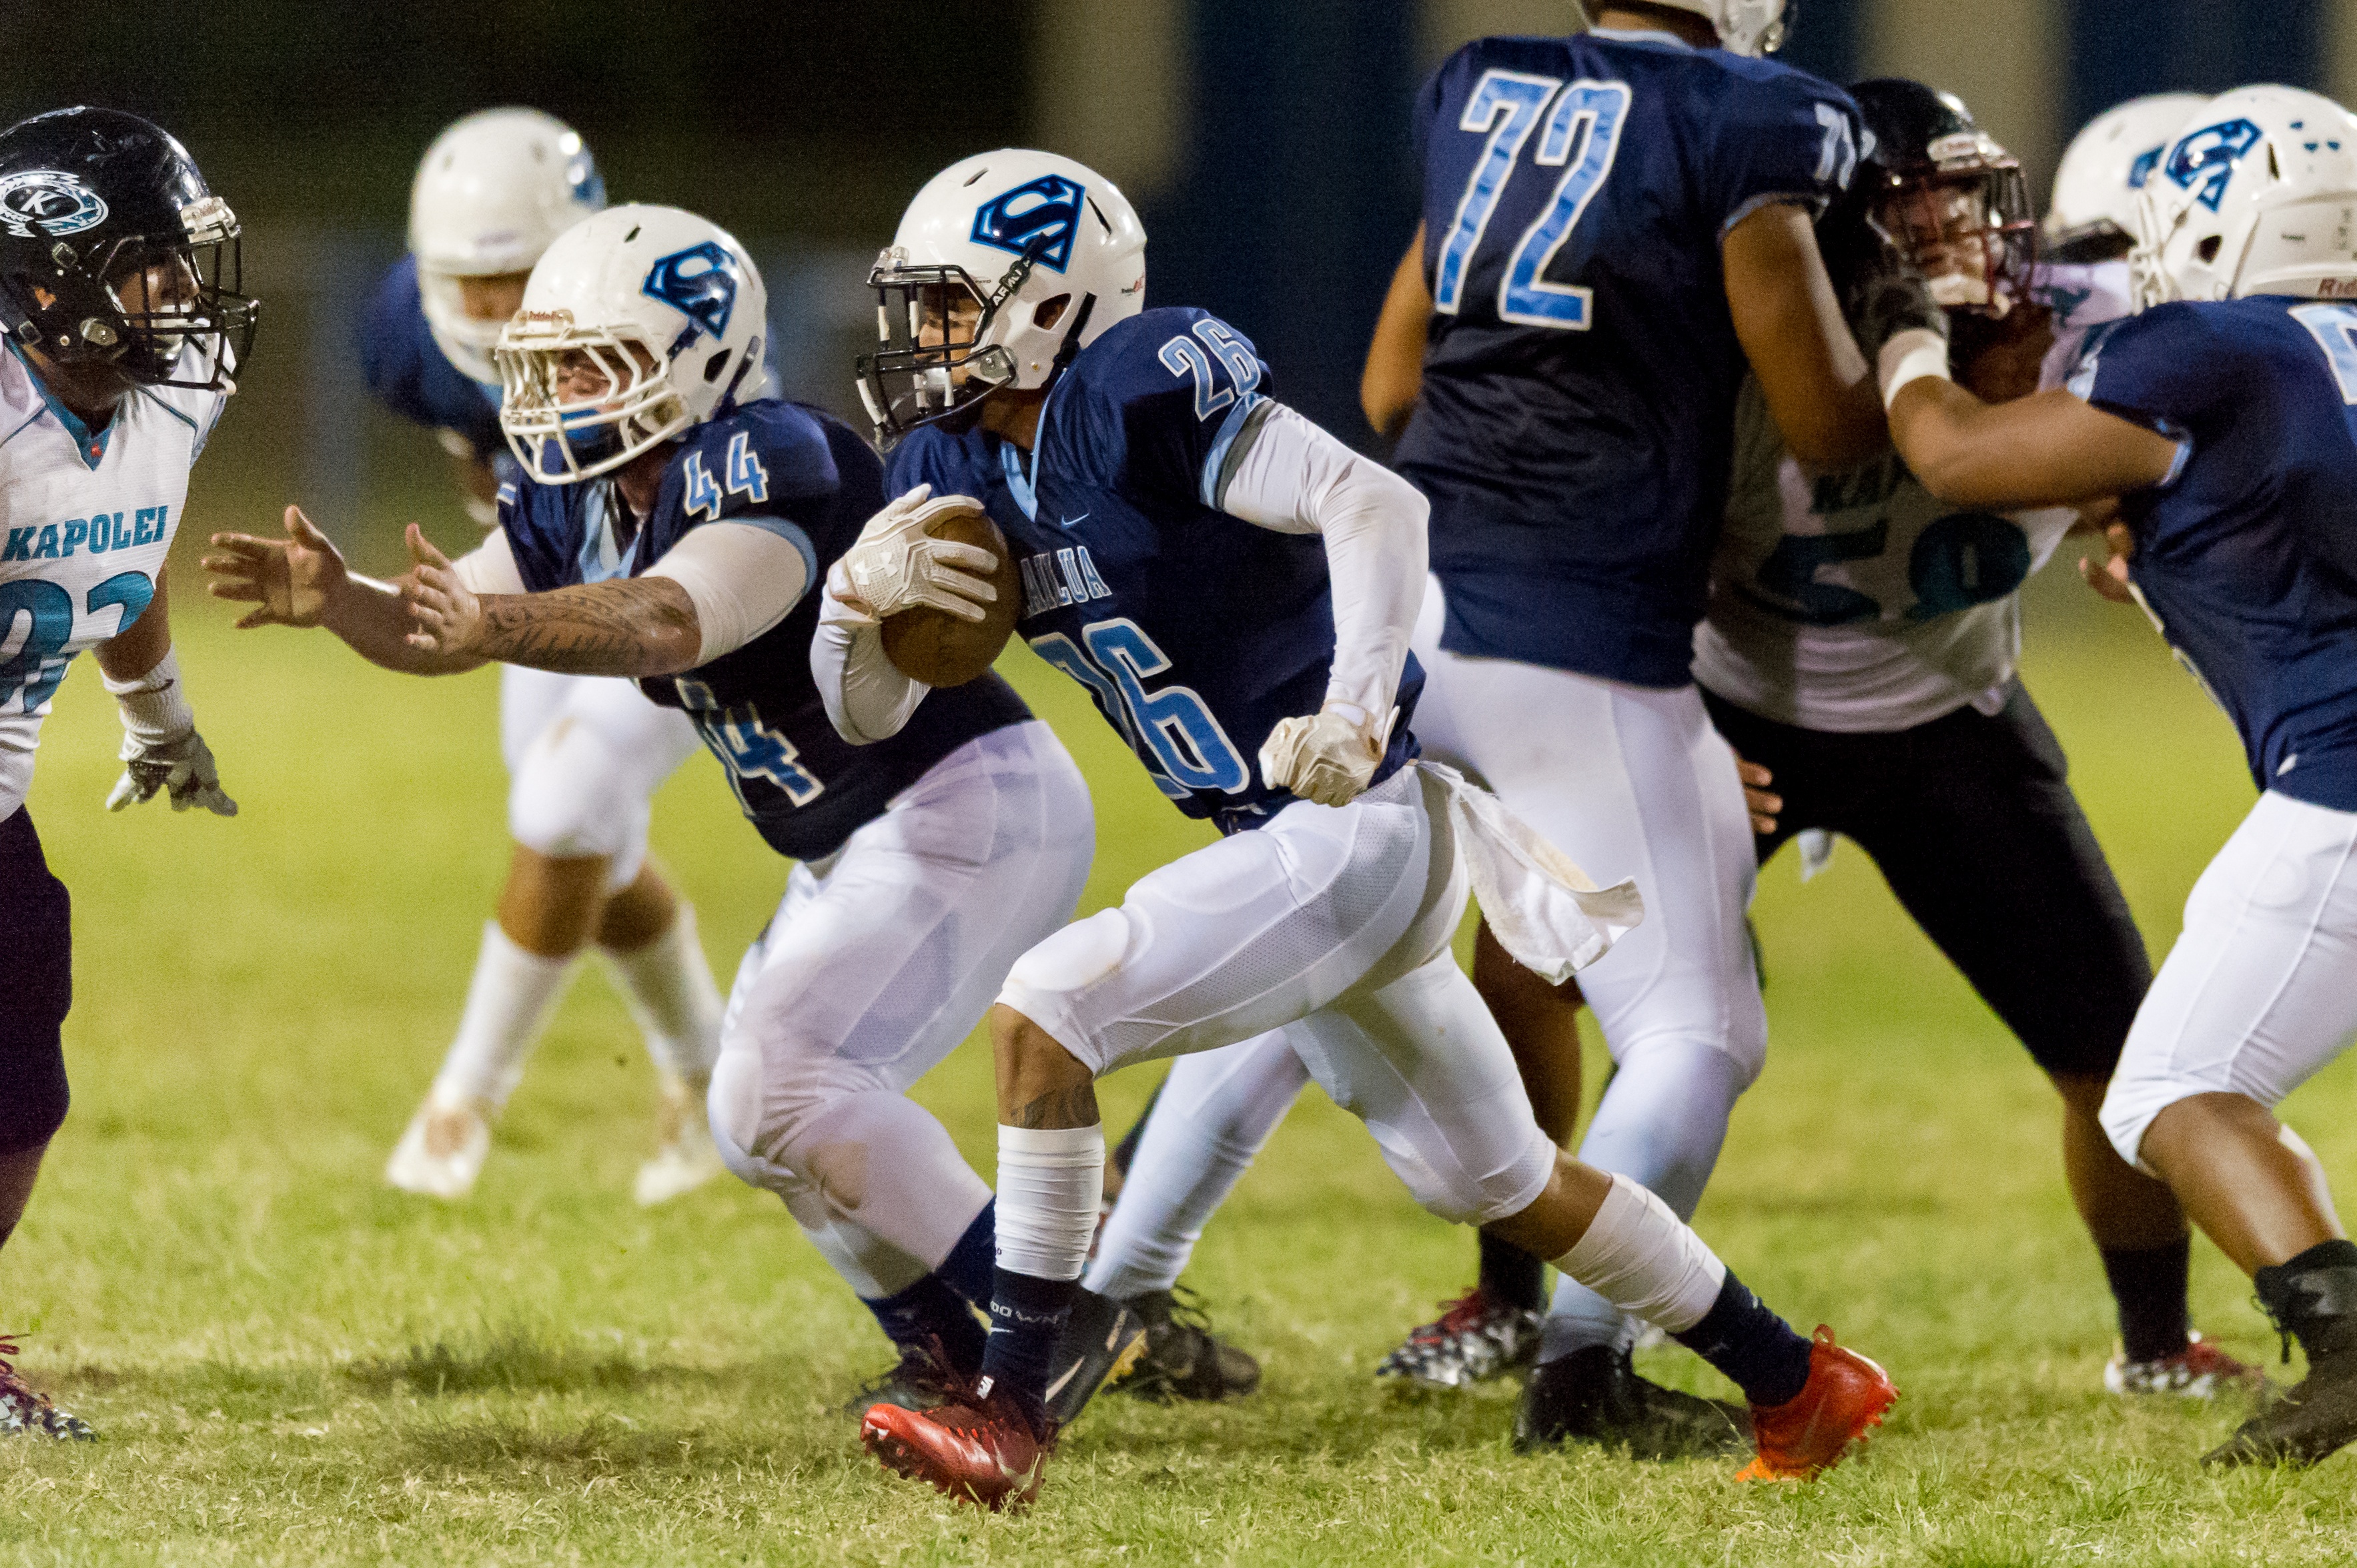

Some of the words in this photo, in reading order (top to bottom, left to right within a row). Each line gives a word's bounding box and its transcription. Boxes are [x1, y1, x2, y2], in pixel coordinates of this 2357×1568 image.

[19, 189, 62, 216] K
[1436, 69, 1632, 331] 72
[1158, 318, 1261, 423] 26
[684, 432, 769, 521] 44
[0, 506, 168, 562] KAPOLEI
